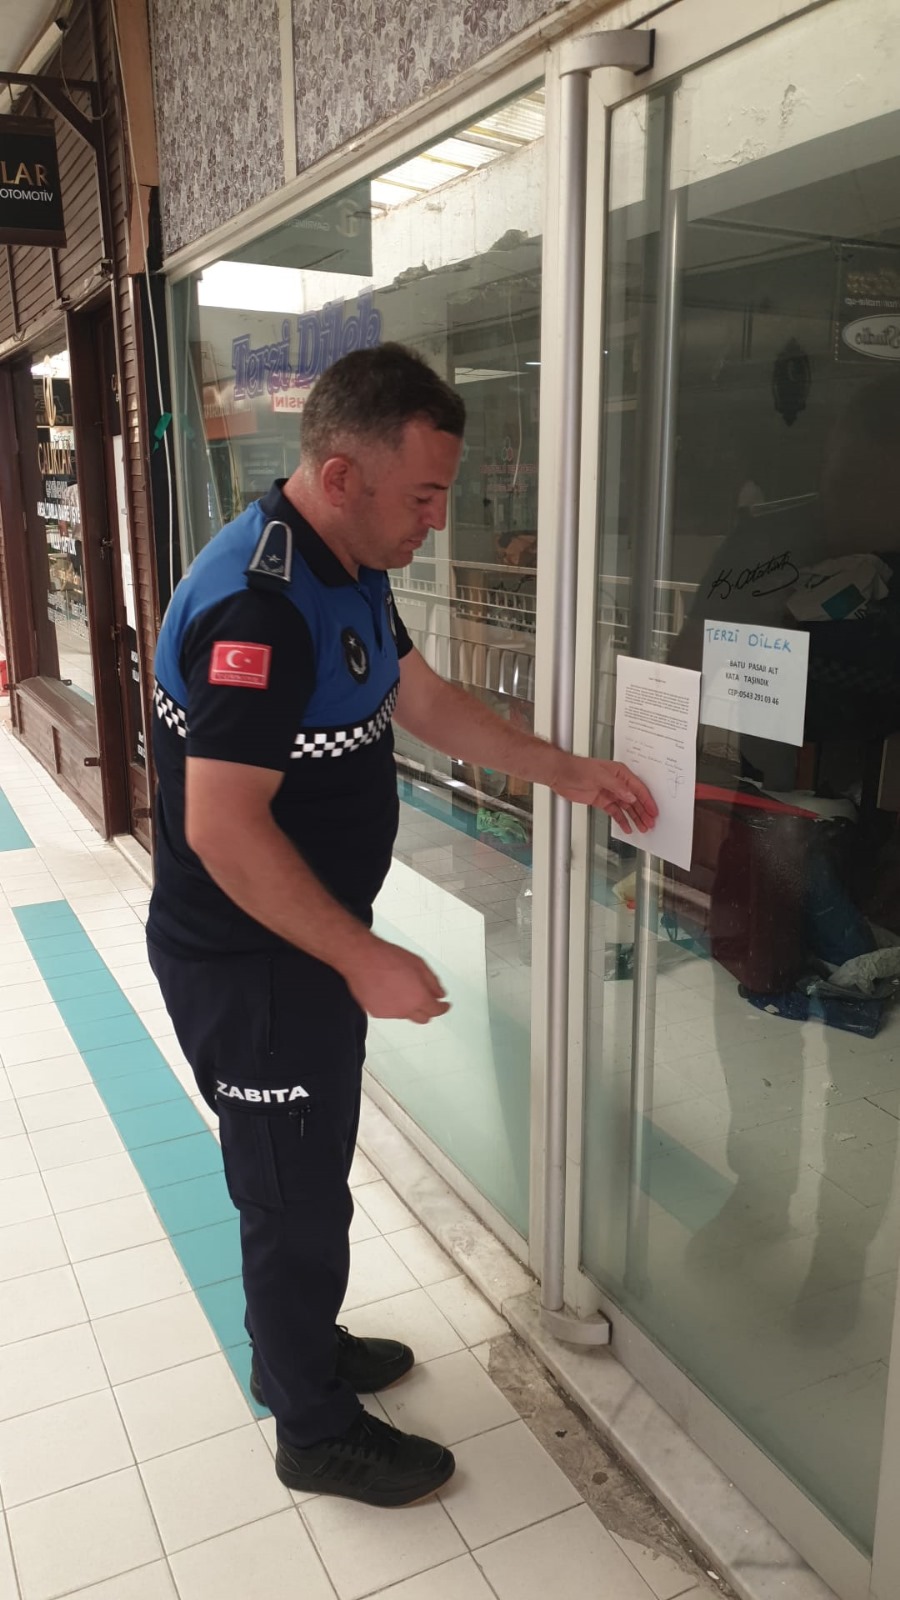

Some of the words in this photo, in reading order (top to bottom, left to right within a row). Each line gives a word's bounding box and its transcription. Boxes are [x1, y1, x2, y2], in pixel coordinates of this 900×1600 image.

[232, 318, 292, 401] Terzi
[748, 633, 791, 653] DİLEK
[725, 672, 739, 681] KATA
[729, 660, 746, 669] BATU
[768, 667, 779, 675] ALT
[217, 1080, 310, 1103] ZABITA
